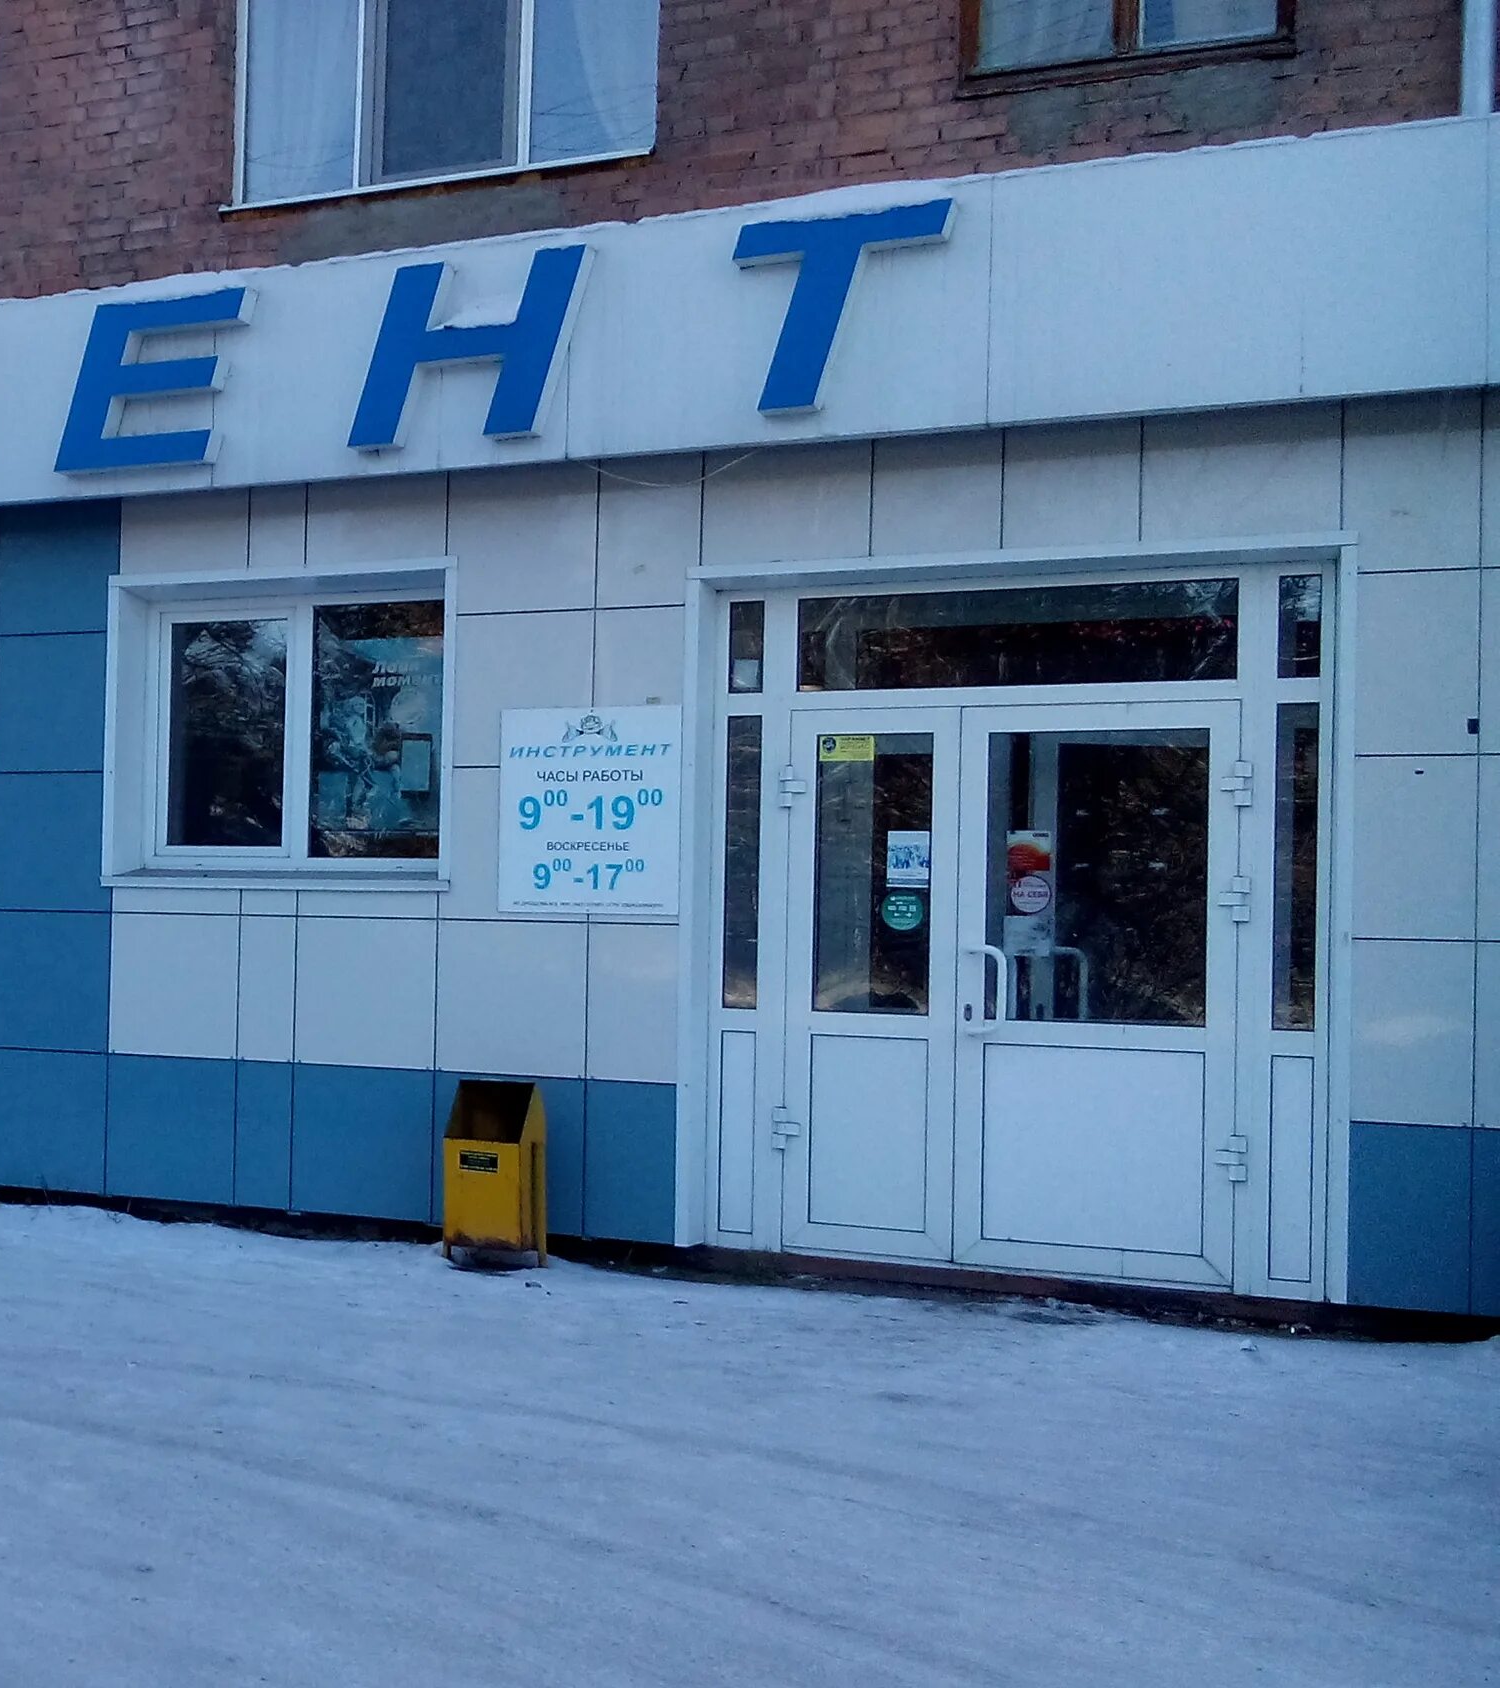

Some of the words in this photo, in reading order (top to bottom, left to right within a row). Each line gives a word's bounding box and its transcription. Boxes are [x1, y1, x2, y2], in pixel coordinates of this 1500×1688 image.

[509, 743, 672, 759] ИНСТРУМЕНТ
[536, 770, 579, 782] ЧАСЫ
[582, 769, 644, 782] РАБОТЫ
[546, 841, 630, 851] ВОСКРЕСЕНЬЕ
